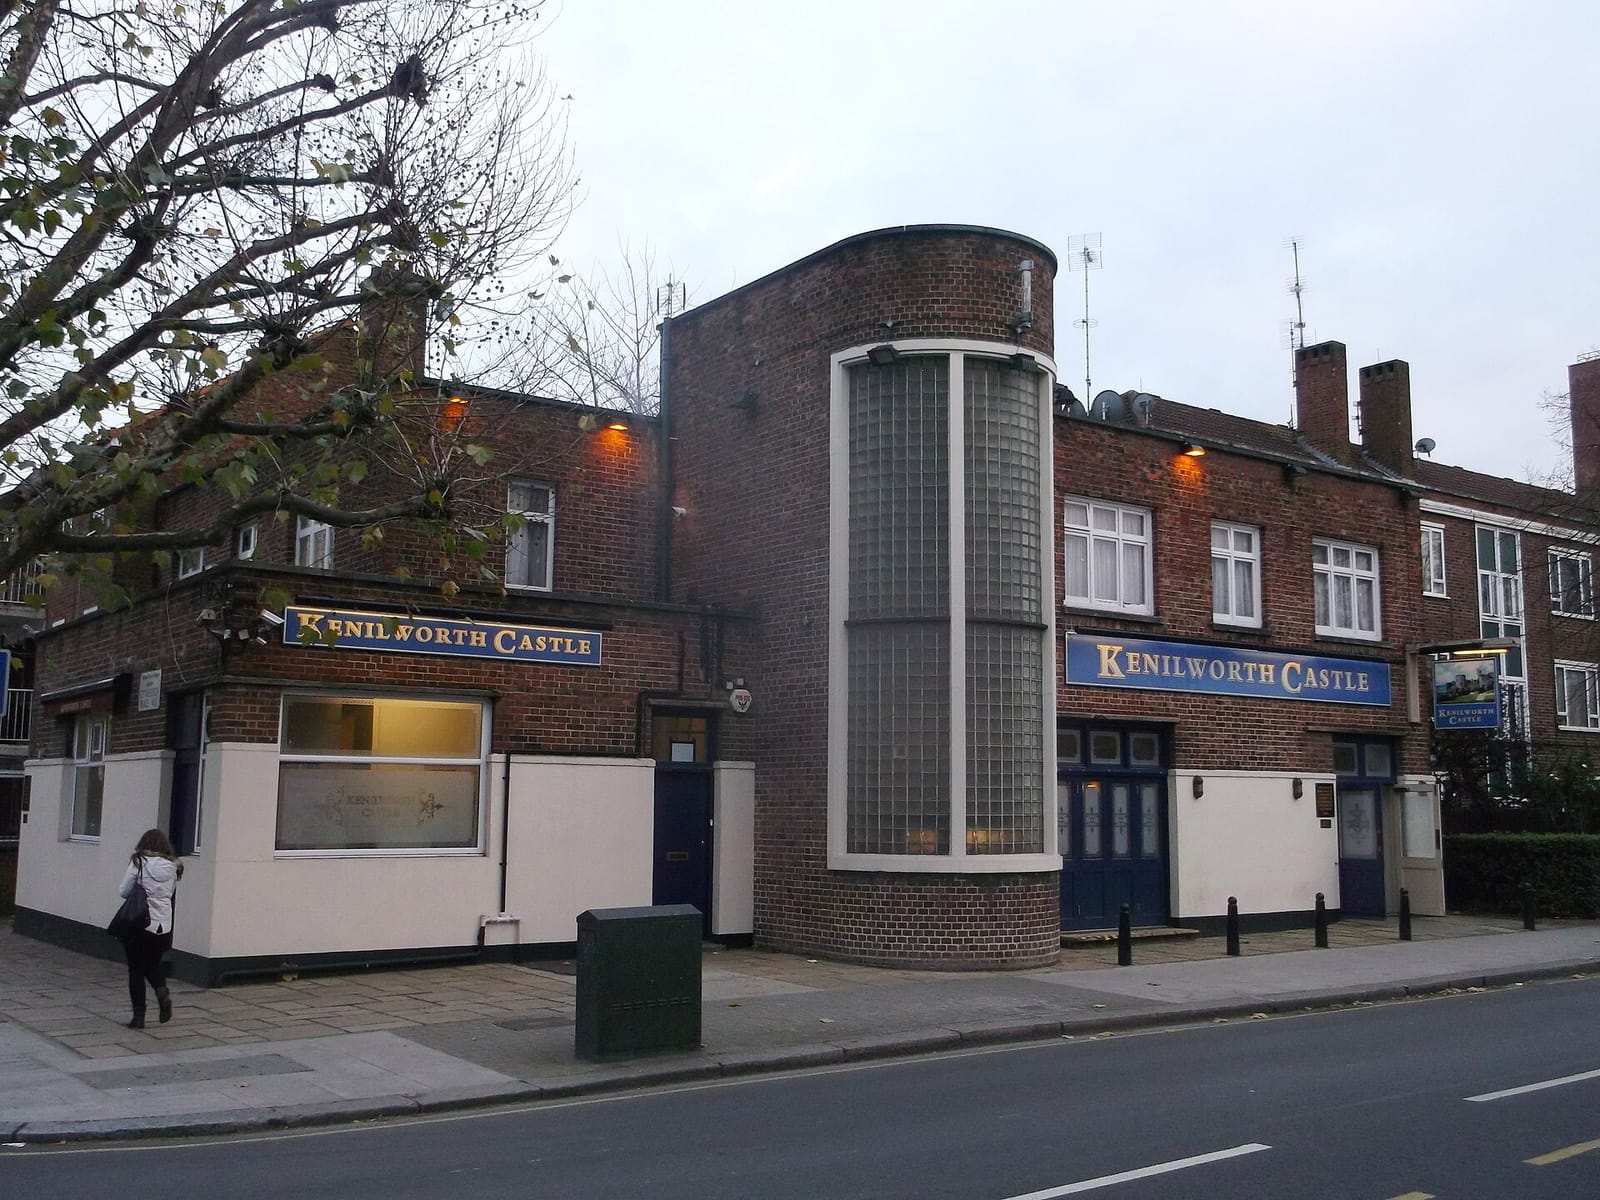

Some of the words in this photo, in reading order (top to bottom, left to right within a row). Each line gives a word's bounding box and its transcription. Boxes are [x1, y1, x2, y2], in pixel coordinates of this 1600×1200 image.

[494, 630, 591, 655] CASTLE
[1096, 644, 1274, 684] KENILWORTH
[1280, 661, 1369, 693] CASTLE
[1439, 709, 1494, 717] KENILWORTH
